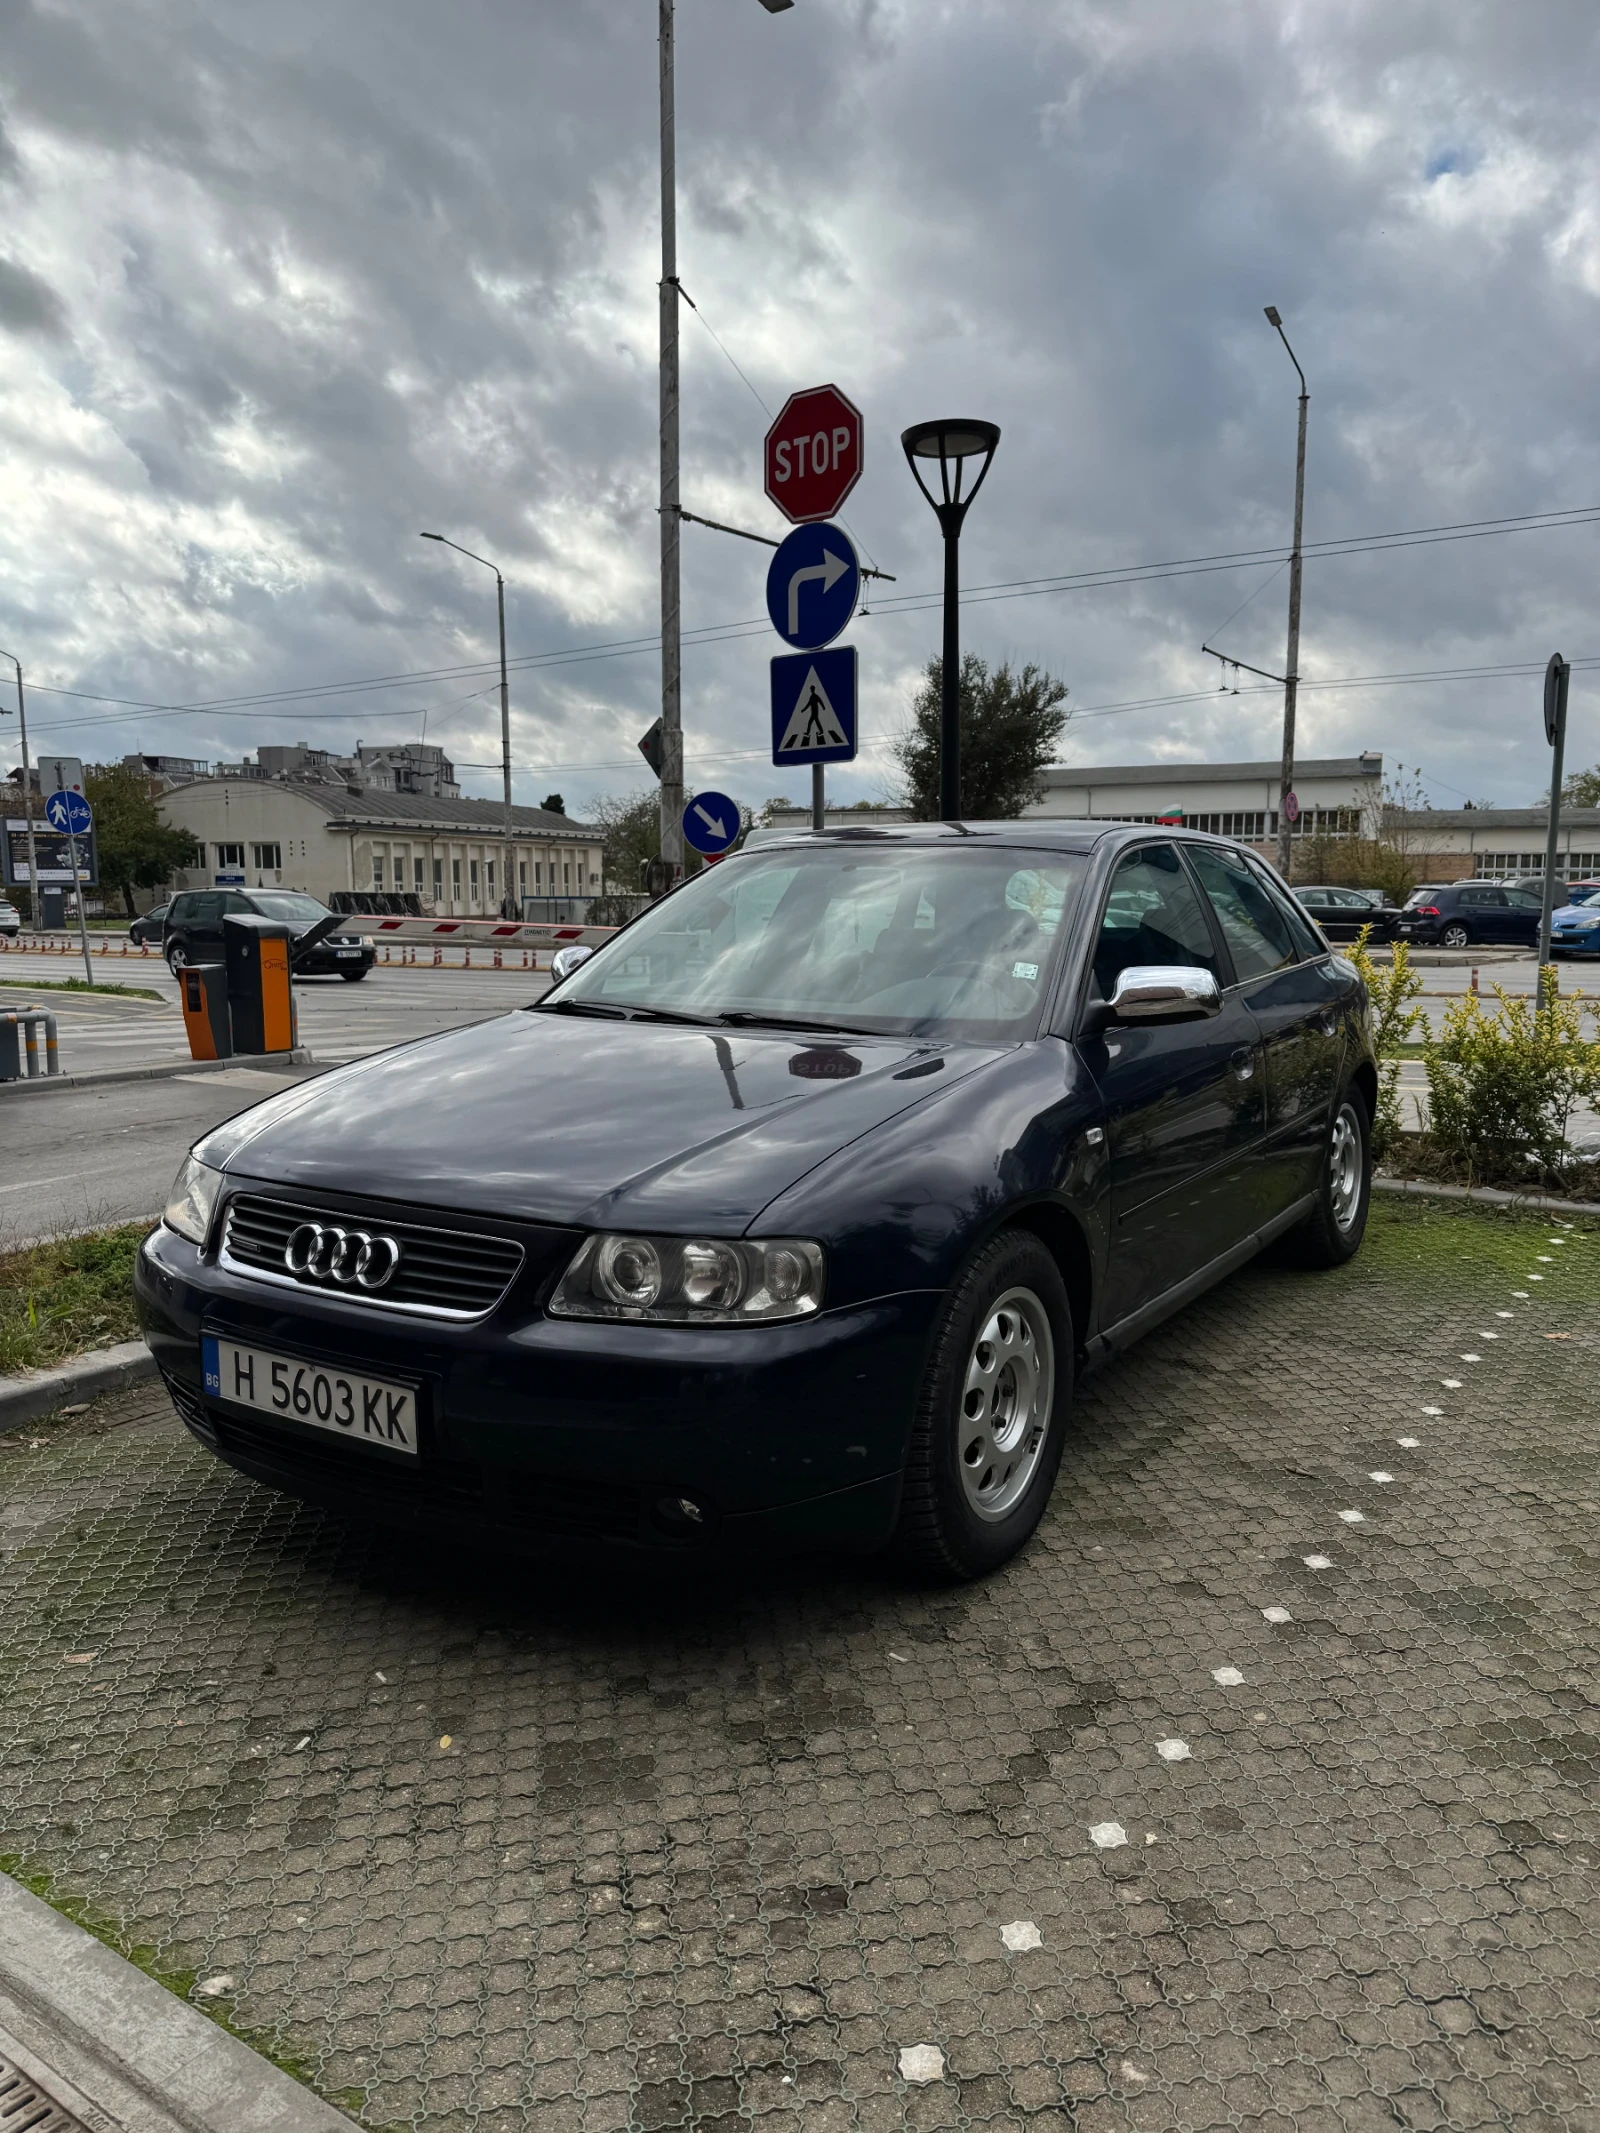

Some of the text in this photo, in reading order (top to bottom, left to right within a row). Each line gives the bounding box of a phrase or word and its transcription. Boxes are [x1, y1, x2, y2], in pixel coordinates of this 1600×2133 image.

[775, 426, 850, 482] STOP
[206, 1372, 219, 1388] BG
[234, 1350, 255, 1400] H
